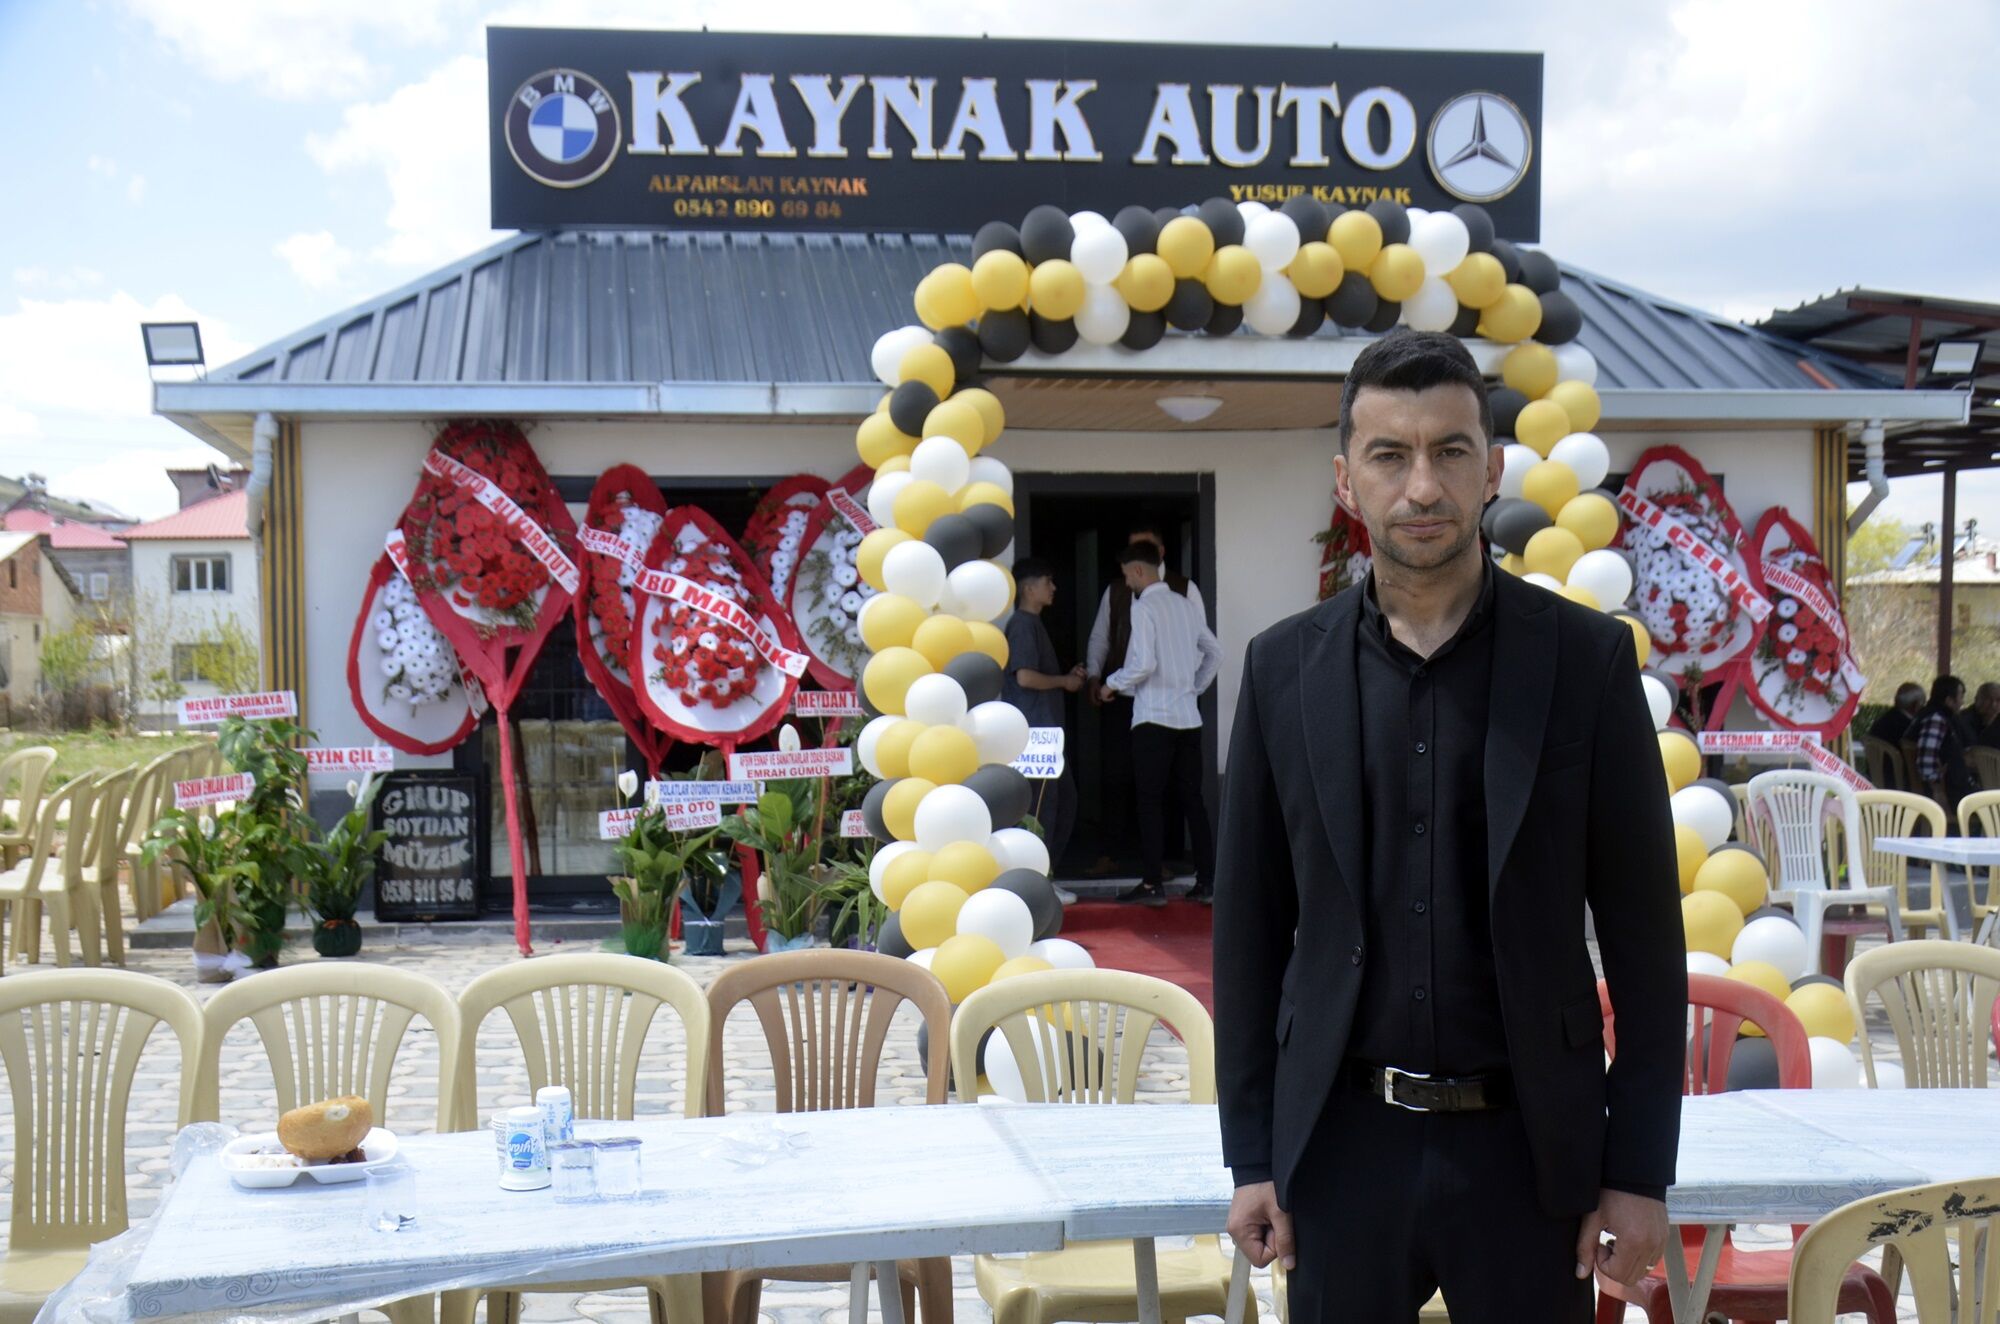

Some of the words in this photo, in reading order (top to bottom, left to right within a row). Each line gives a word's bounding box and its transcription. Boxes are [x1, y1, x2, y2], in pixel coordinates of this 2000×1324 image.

[519, 74, 608, 114] BMW
[627, 71, 1103, 162] KAYNAK
[1132, 81, 1417, 170] AUTO
[648, 174, 774, 193] ALPARSLAN
[779, 176, 868, 196] KAYNAK
[1312, 185, 1412, 205] KAYNAK
[673, 198, 728, 218] 0542
[733, 198, 776, 218] 890
[682, 586, 793, 669] MAMUK
[1031, 730, 1060, 744] OLSUN
[307, 748, 344, 763] EYİN
[747, 768, 786, 779] EMRAH
[688, 800, 715, 813] OTO
[383, 816, 469, 837] SOYDAN
[382, 837, 471, 871] MÜZİK
